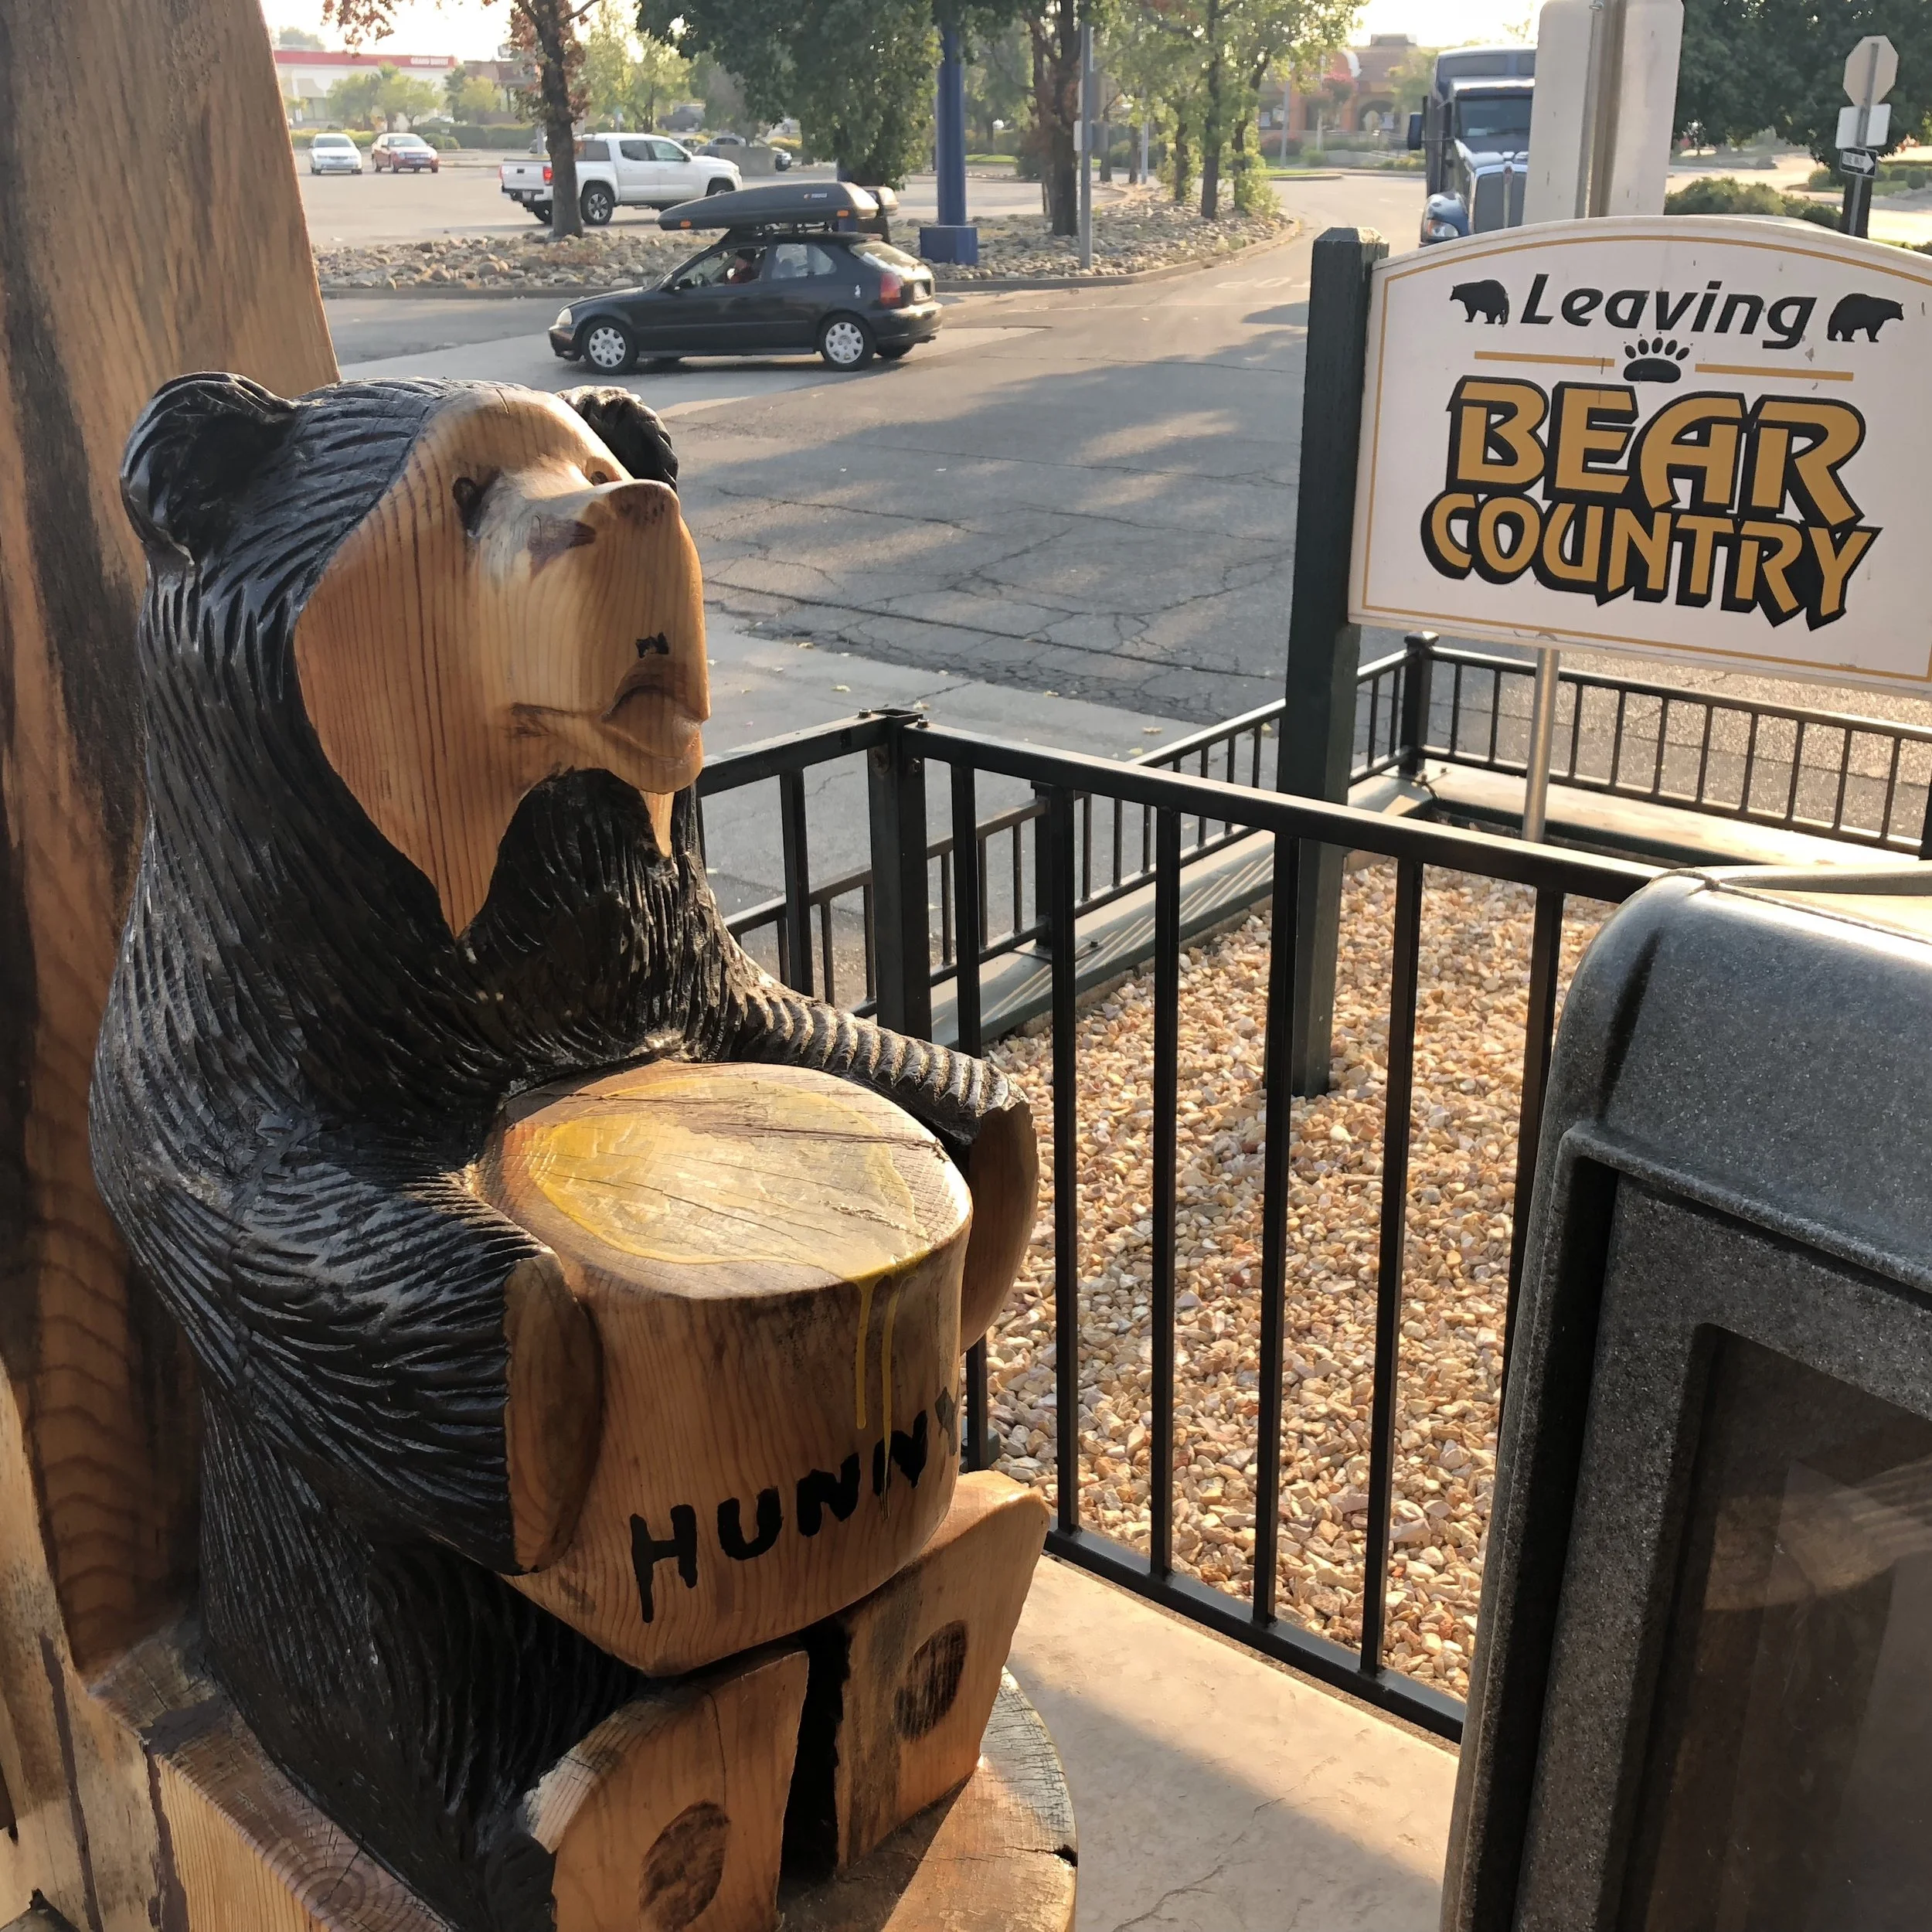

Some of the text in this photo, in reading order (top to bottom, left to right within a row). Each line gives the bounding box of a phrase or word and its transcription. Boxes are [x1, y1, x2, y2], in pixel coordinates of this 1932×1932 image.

[1521, 274, 1817, 349] Leaving
[1446, 375, 1866, 529] BEAR
[1420, 491, 1883, 631] COUNTRY
